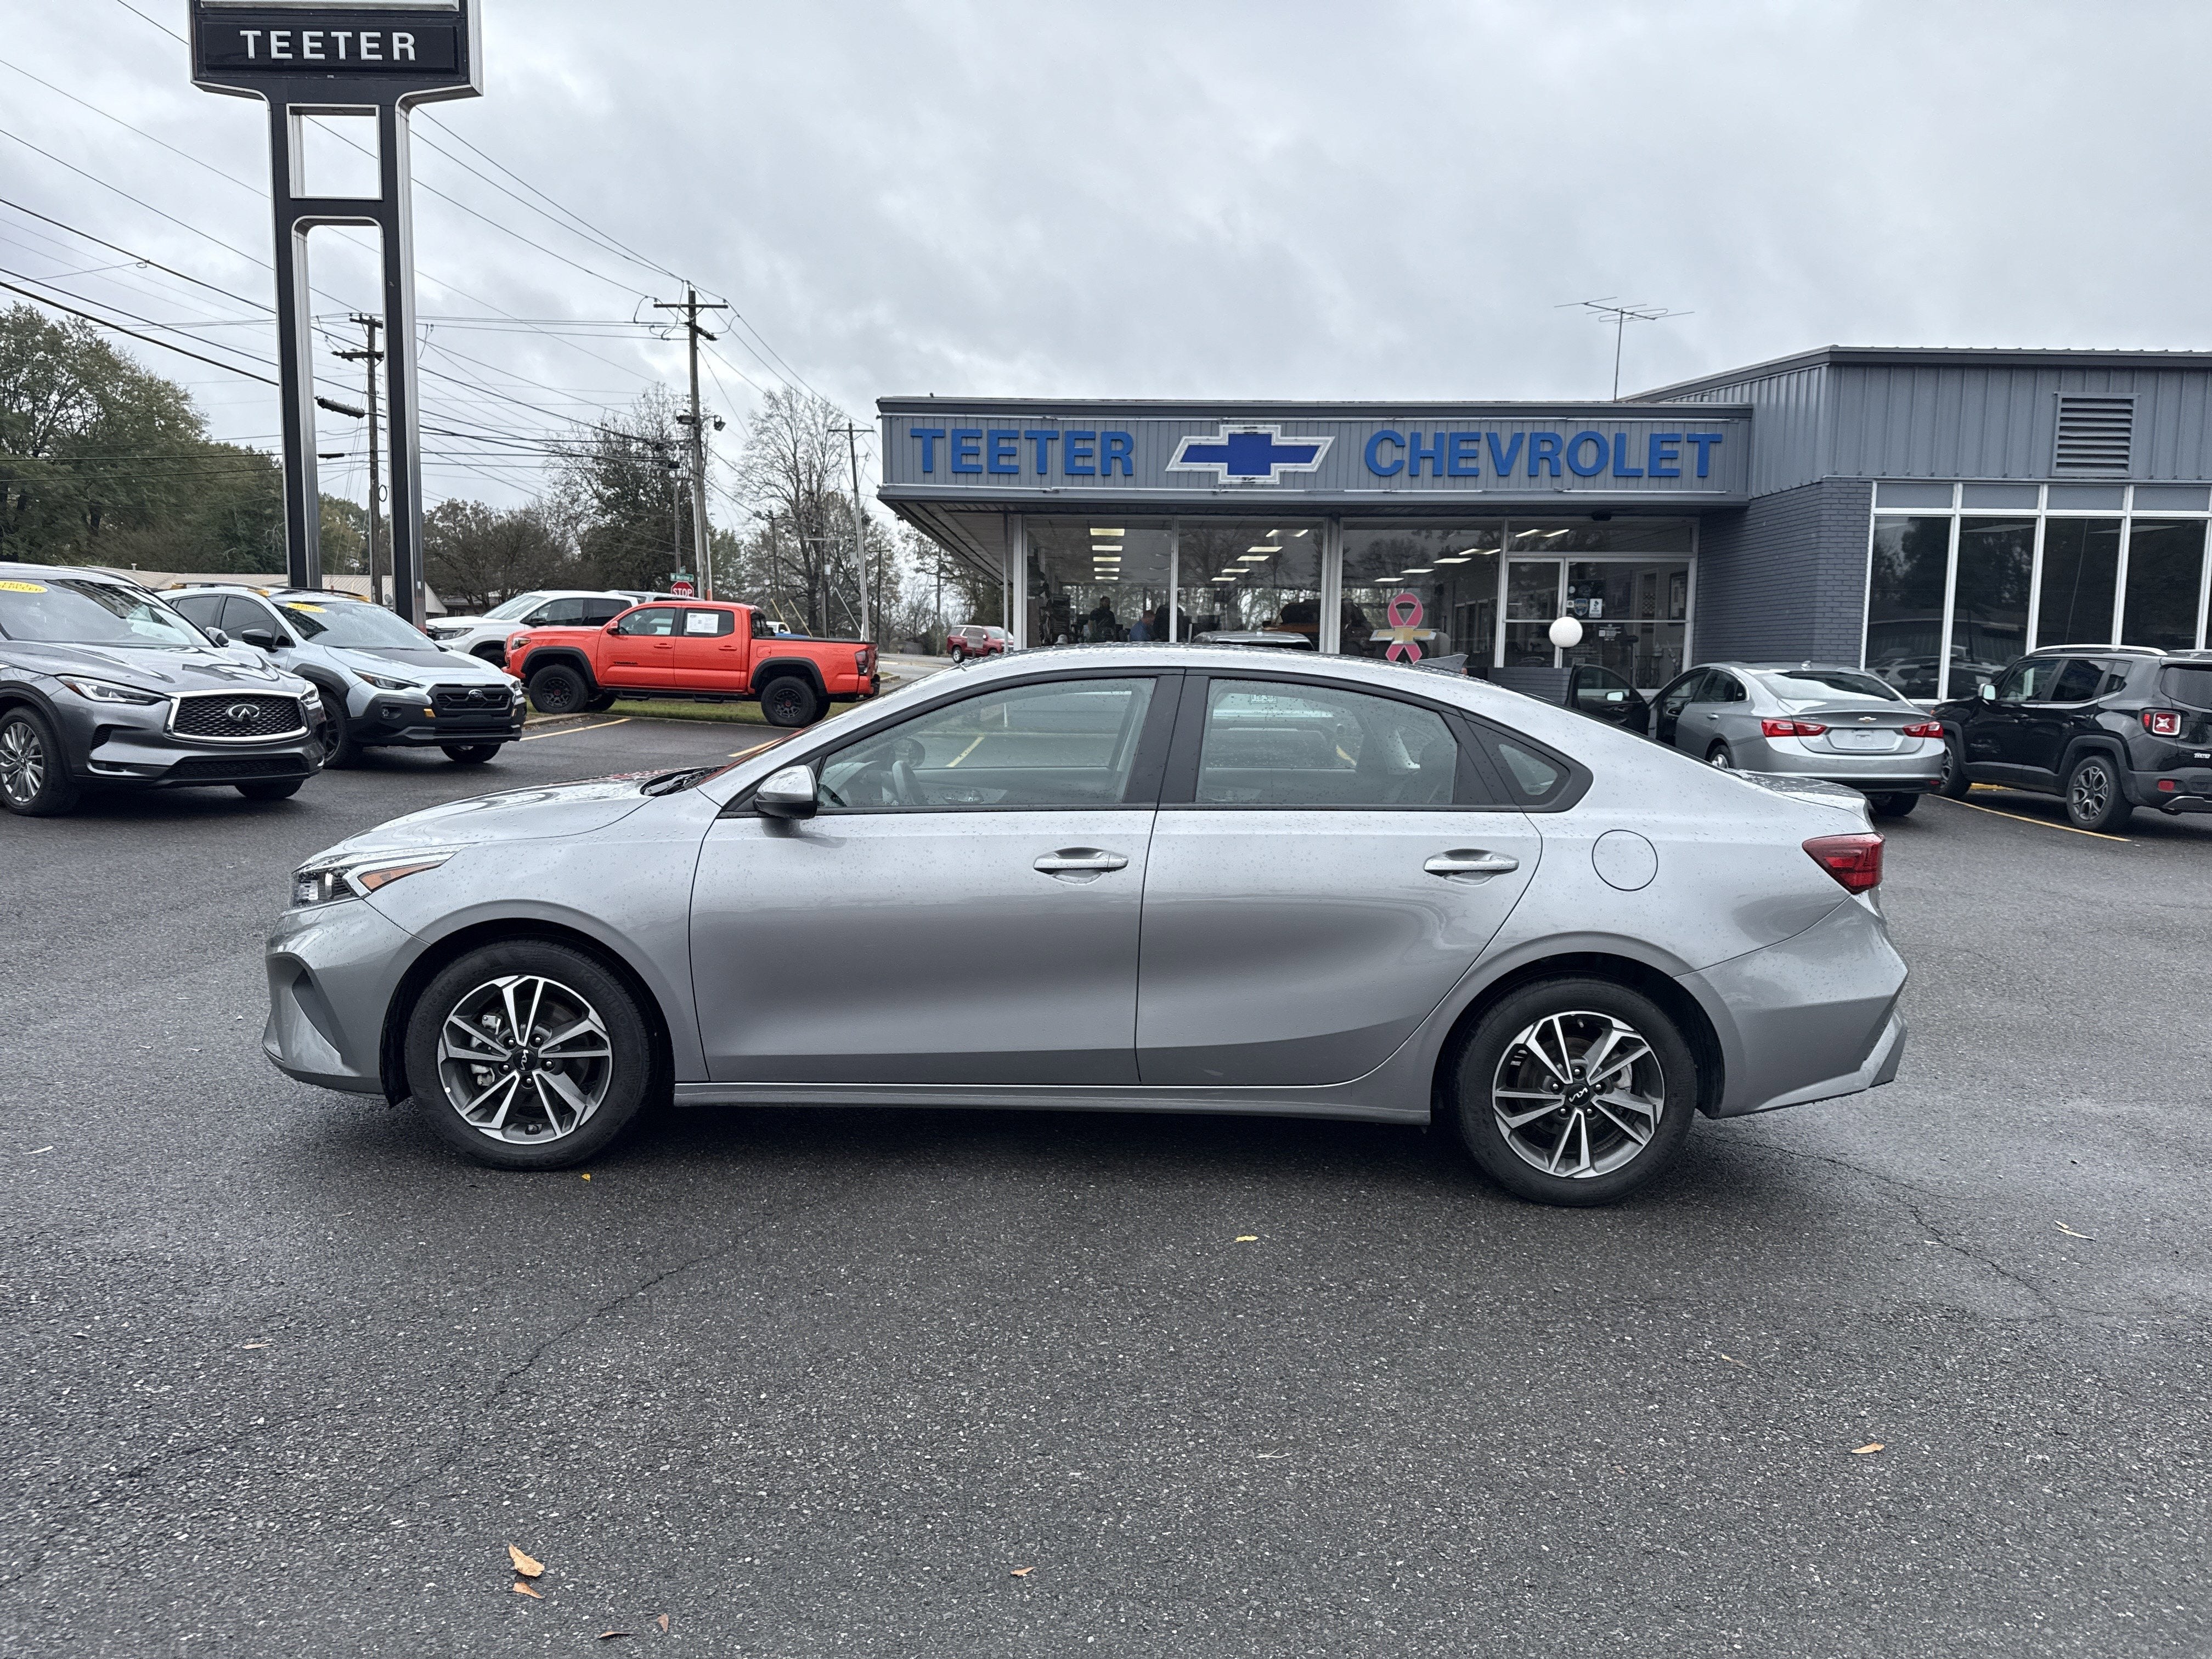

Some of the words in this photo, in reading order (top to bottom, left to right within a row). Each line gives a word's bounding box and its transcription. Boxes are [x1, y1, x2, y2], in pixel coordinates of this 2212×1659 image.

[240, 30, 415, 61] TEETER
[910, 428, 1134, 476] TEETER
[1365, 430, 1723, 477] CHEVROLET
[673, 588, 692, 597] STOP
